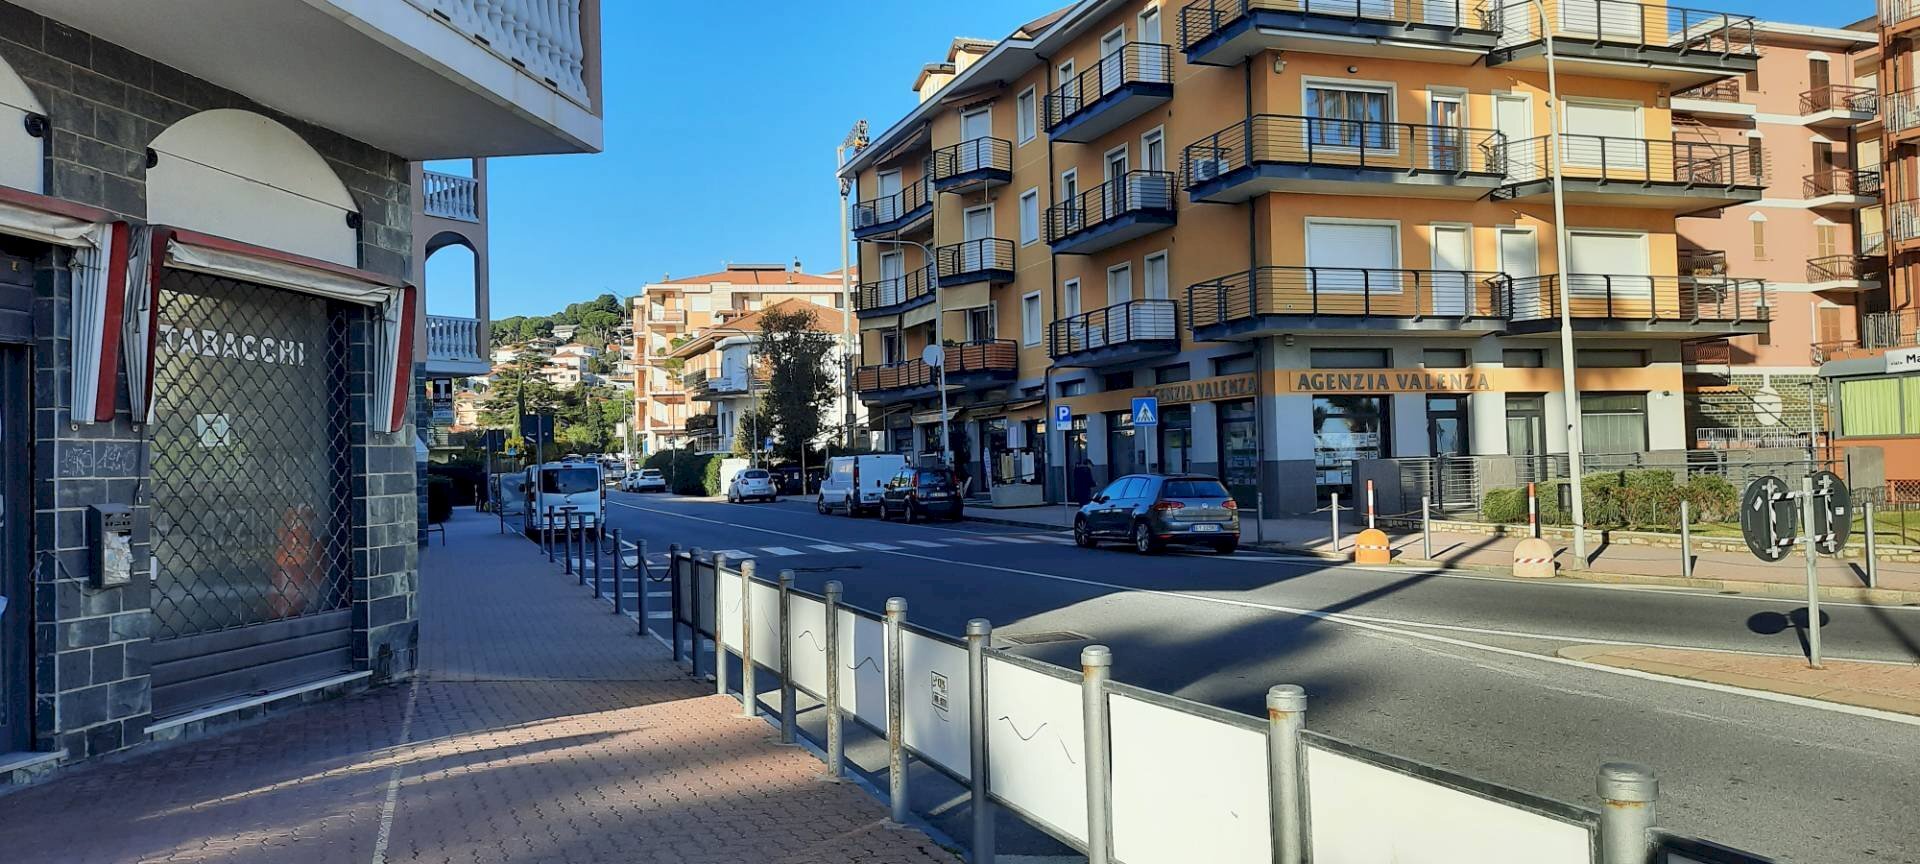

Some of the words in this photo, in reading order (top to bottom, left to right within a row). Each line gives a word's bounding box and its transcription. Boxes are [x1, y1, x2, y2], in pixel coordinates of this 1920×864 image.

[159, 324, 305, 367] TABACCHI
[435, 379, 450, 399] T
[1197, 376, 1257, 399] VALENZA
[1298, 373, 1390, 391] AGENZIA
[1396, 373, 1490, 390] VALENZA
[1059, 406, 1069, 420] P
